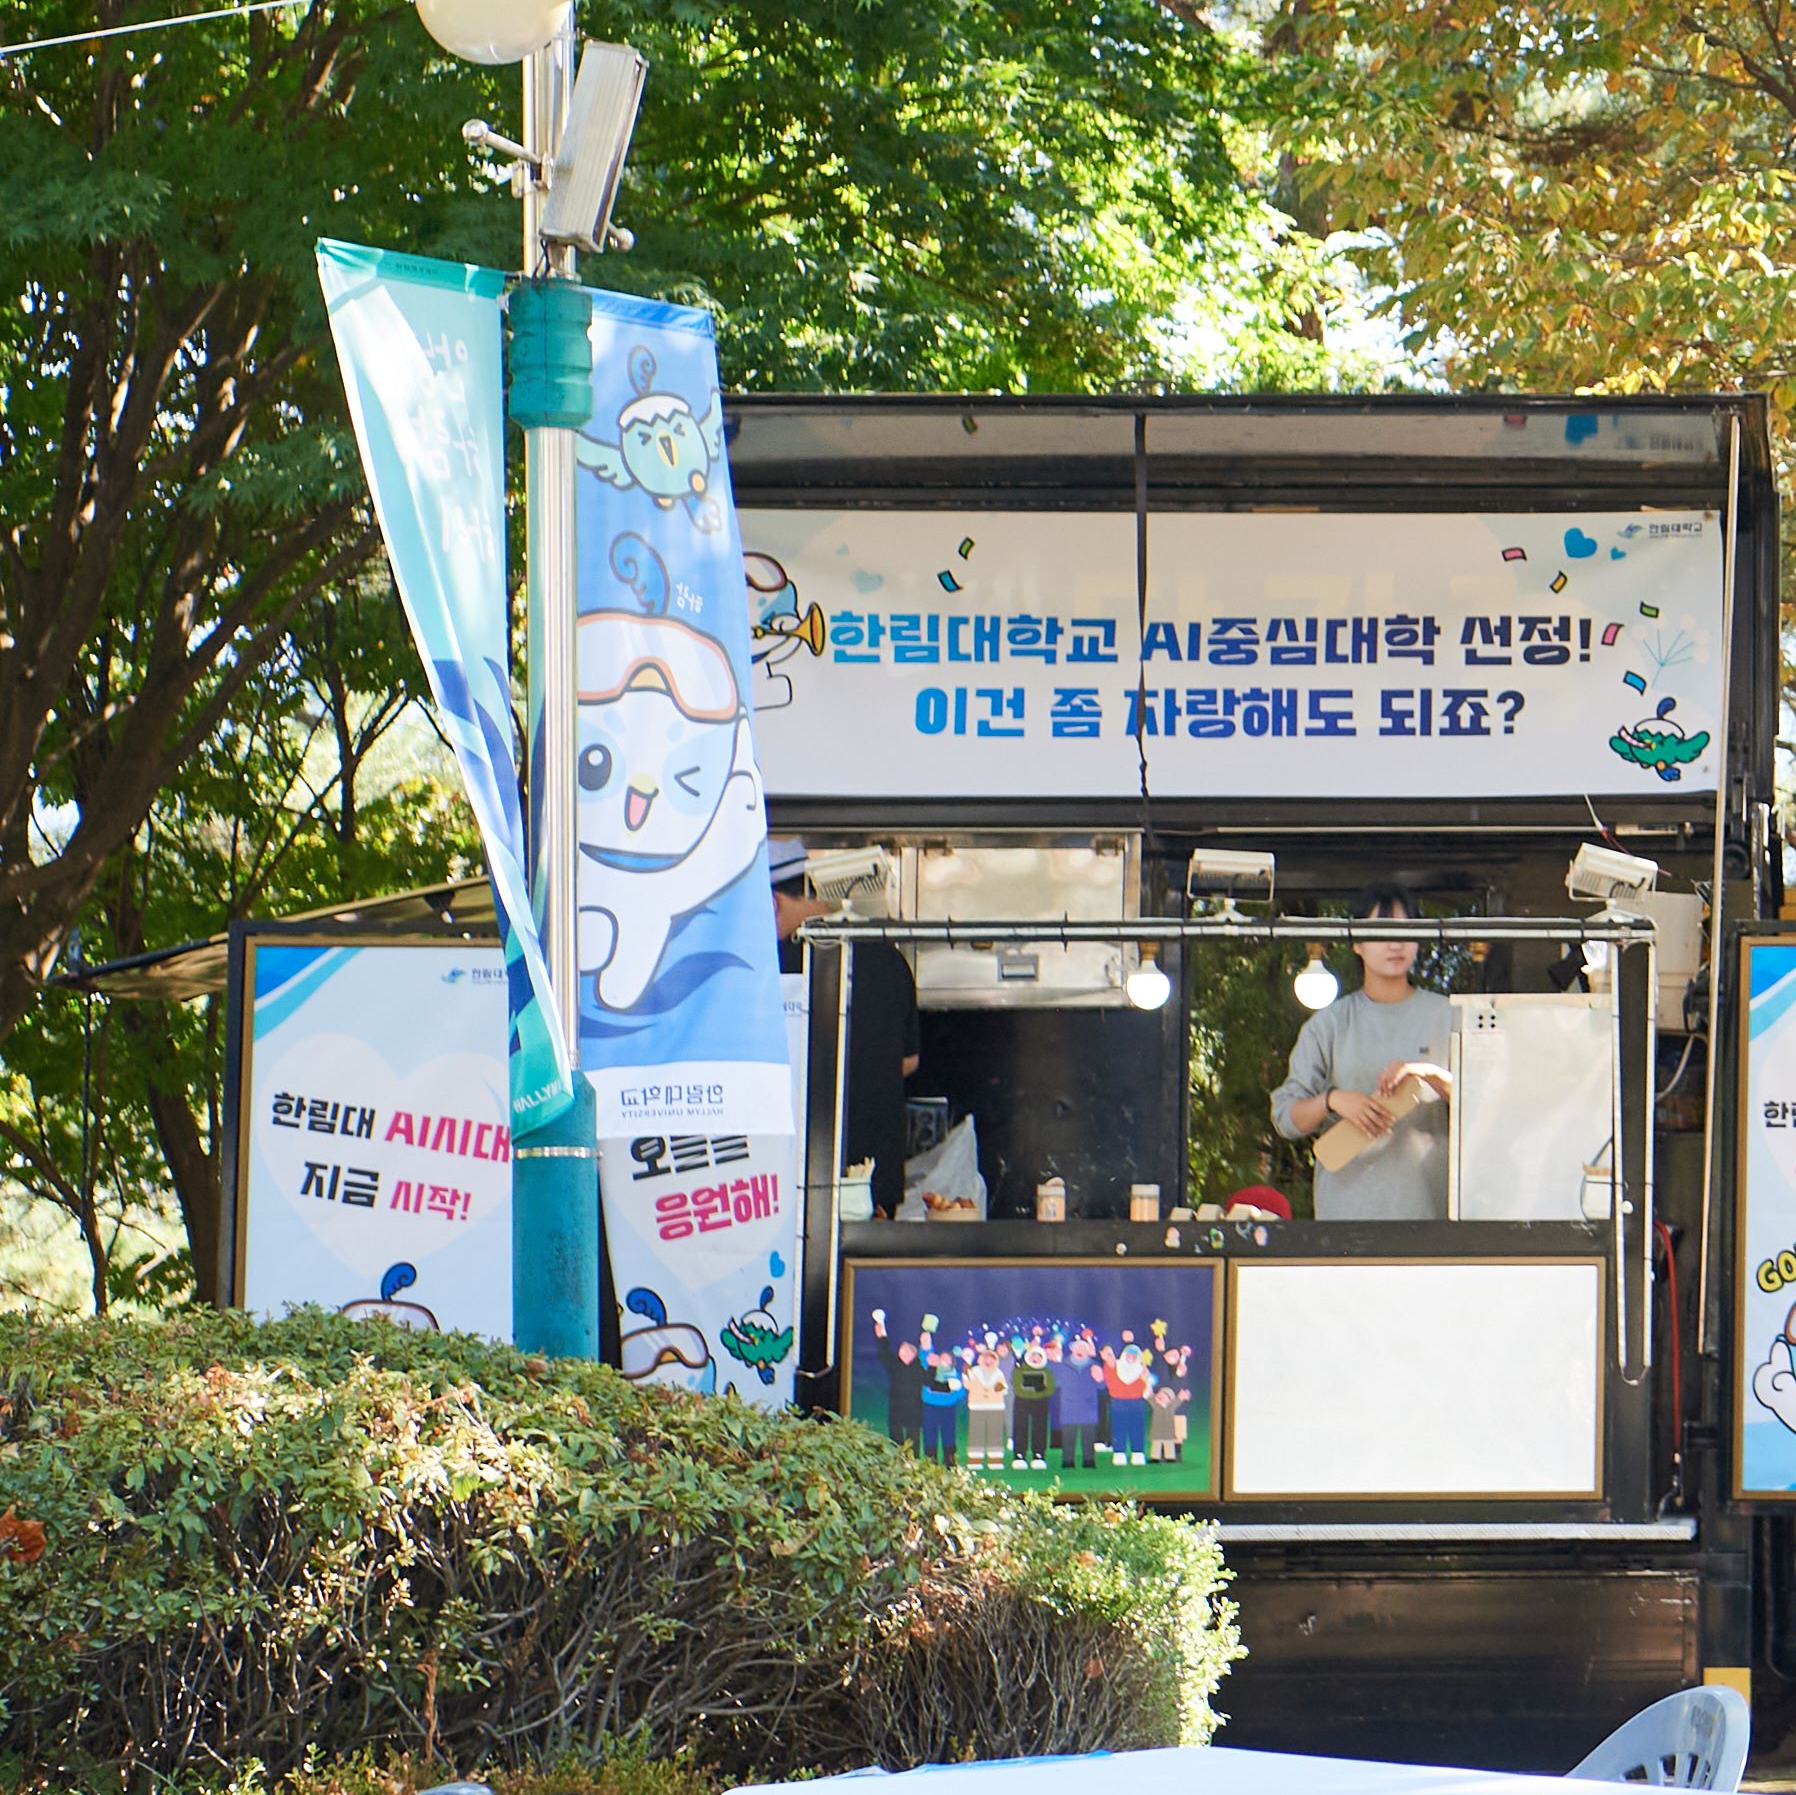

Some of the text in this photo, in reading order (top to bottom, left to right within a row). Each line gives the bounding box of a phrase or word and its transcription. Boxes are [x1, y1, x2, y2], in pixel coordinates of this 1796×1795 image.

[829, 615, 1592, 666] 한림대학교 AI중심대학 선정!
[914, 688, 1525, 737] 이건 좀 자랑해도 되죠?
[272, 1091, 375, 1139] 한림대
[300, 1161, 471, 1220] 지금 시작!
[655, 1174, 779, 1241] 응원해!
